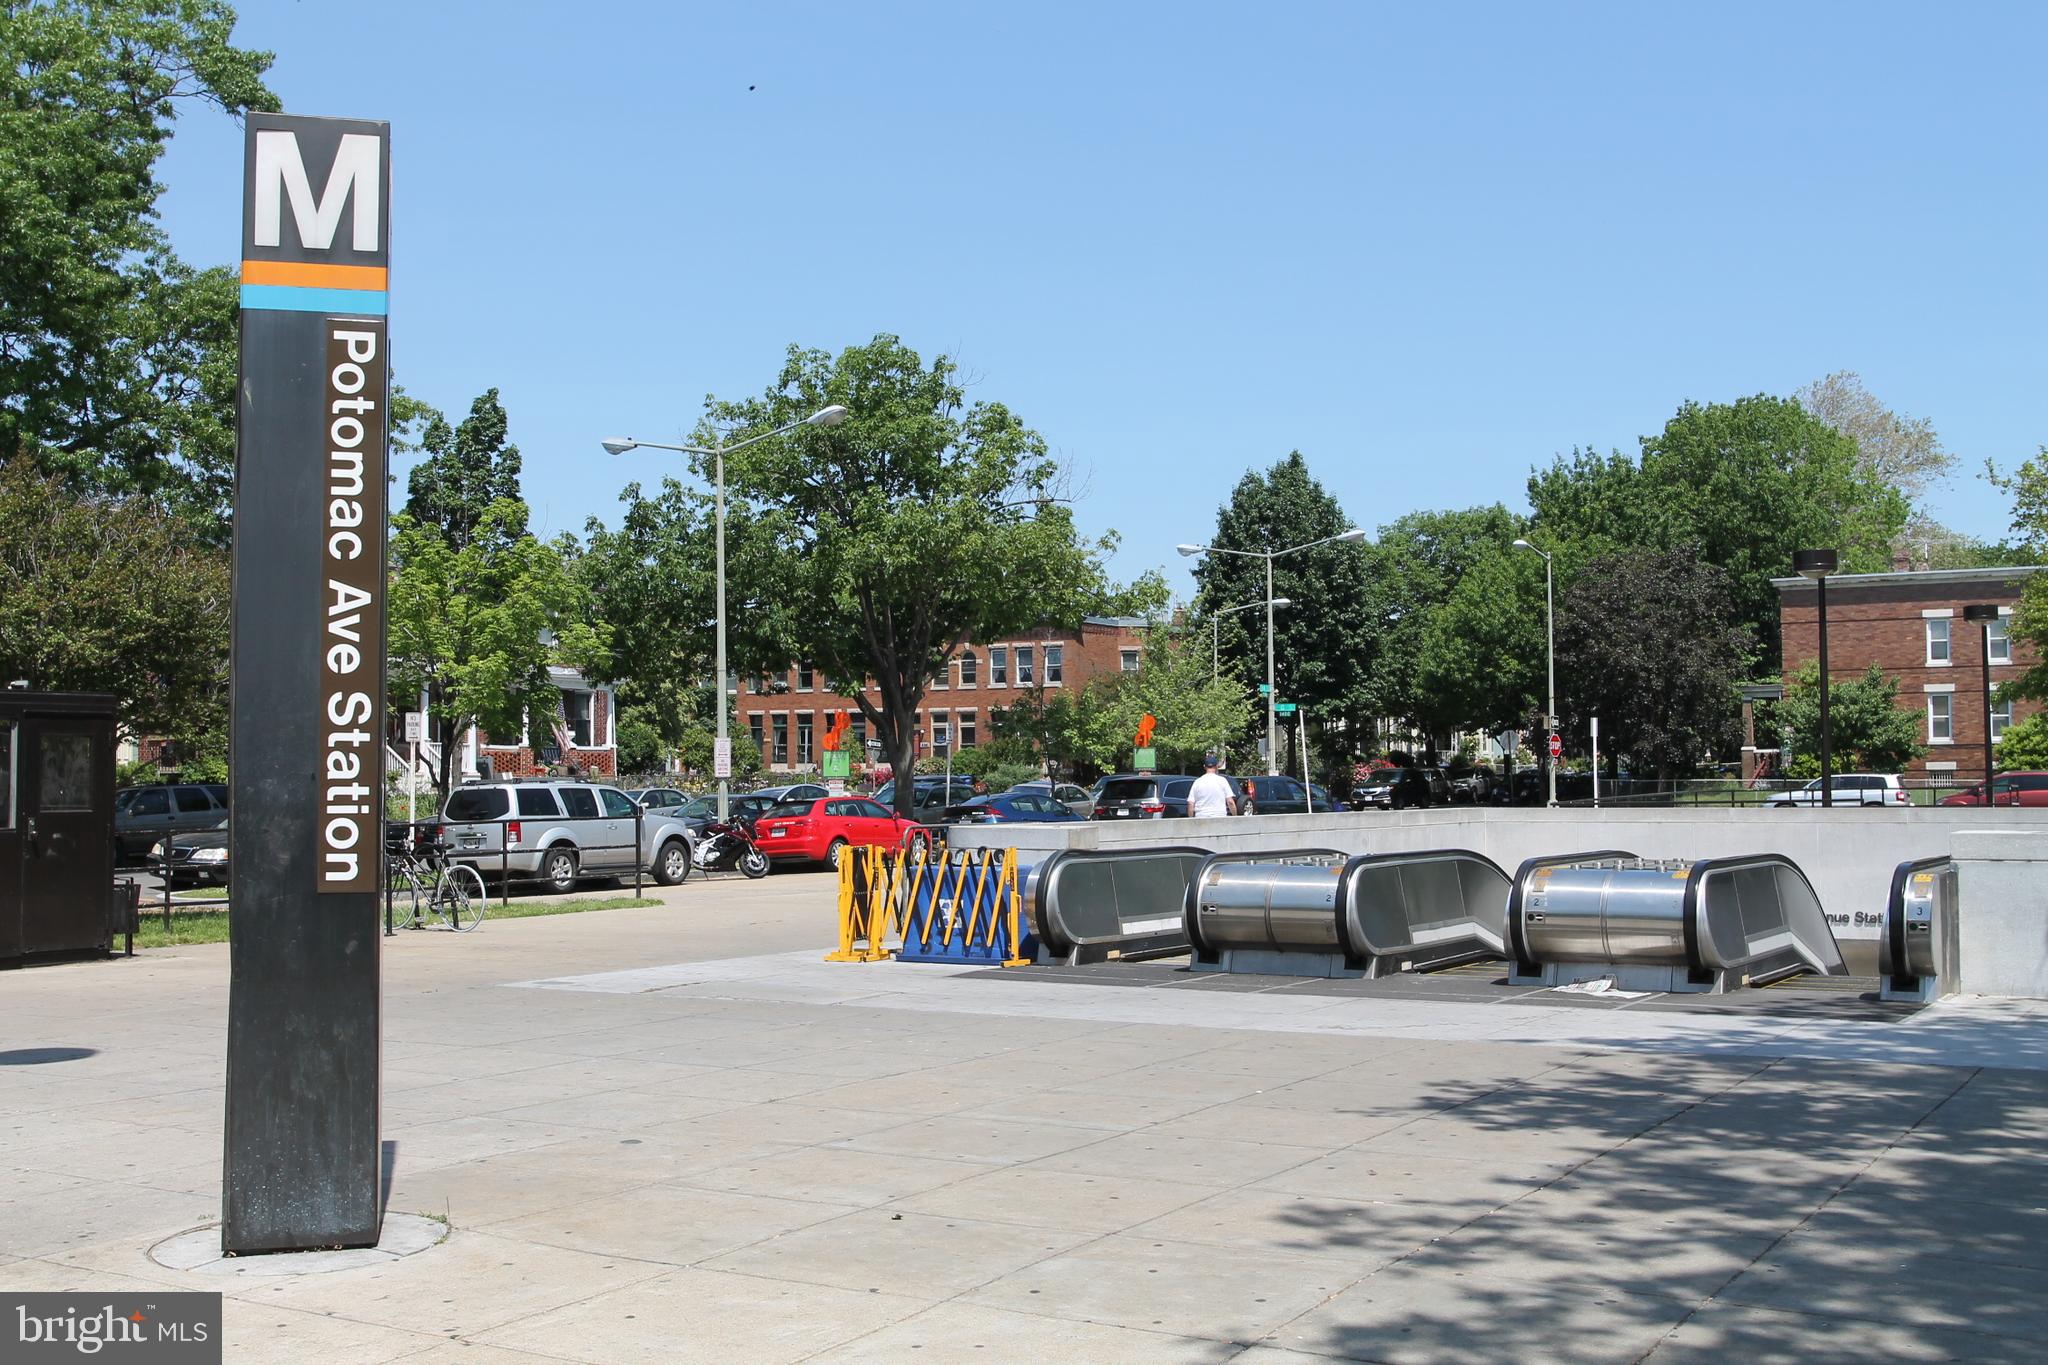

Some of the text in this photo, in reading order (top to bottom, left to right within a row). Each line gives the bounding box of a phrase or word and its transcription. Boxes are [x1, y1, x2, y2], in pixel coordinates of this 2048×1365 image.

[254, 131, 381, 252] M
[325, 330, 377, 882] Potomac Ave Station
[1550, 741, 1561, 750] STOP
[1326, 894, 1332, 902] 2
[1533, 897, 1540, 907] 2
[1916, 906, 1923, 916] 3
